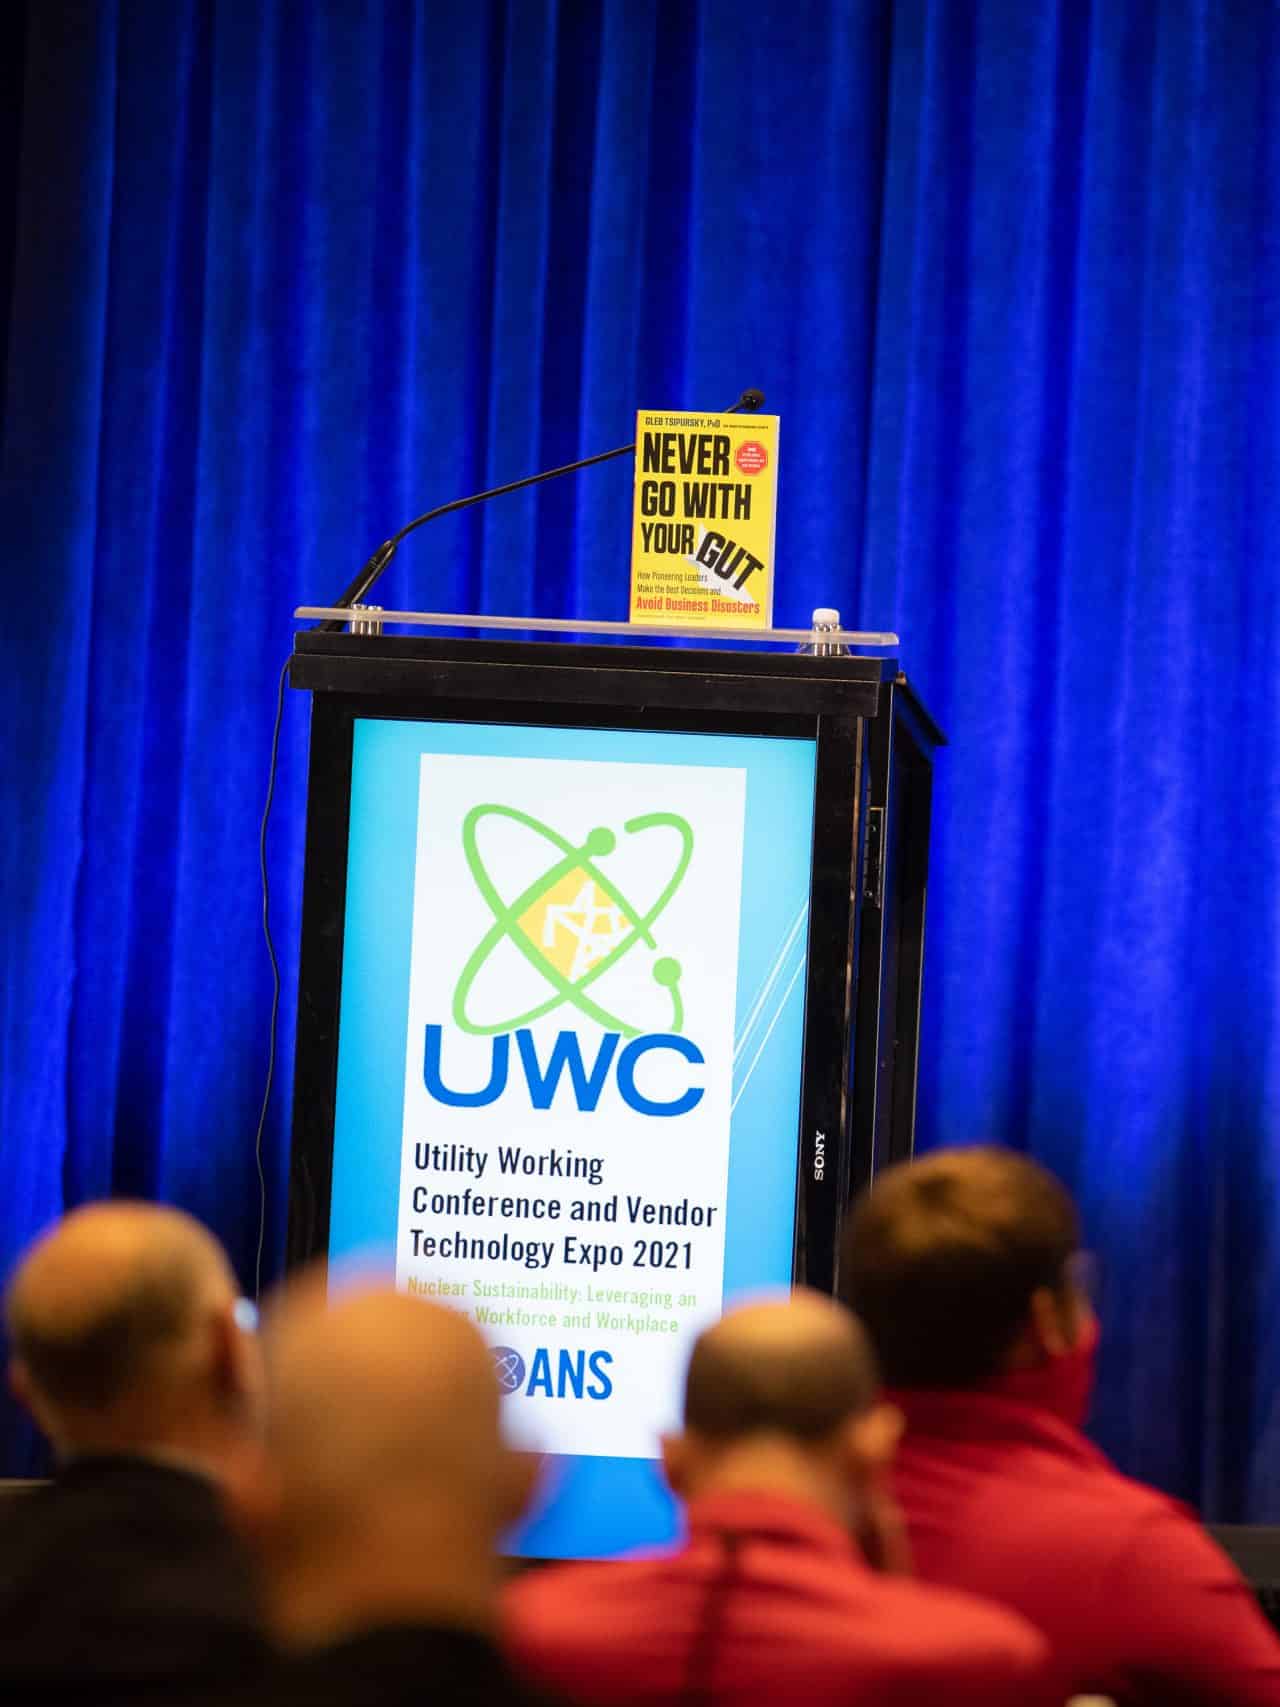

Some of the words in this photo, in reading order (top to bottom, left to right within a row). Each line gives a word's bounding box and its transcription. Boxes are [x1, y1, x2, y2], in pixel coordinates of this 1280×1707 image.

[642, 431, 731, 476] NEVER
[641, 480, 676, 517] GO
[683, 482, 752, 520] WITH
[641, 522, 694, 555] YOUR
[696, 531, 765, 590] GUT
[636, 596, 663, 610] Avoid
[666, 598, 709, 612] Business
[711, 599, 760, 614] Disasters
[637, 583, 654, 593] Make
[654, 584, 665, 593] the
[423, 1024, 705, 1117] UWC
[414, 1142, 489, 1179] Utility
[498, 1146, 605, 1185] Working
[814, 1130, 825, 1181] SONY
[412, 1187, 561, 1220] Conference
[570, 1195, 618, 1223] and
[626, 1196, 718, 1227] Vendor
[410, 1229, 555, 1269] Technology
[563, 1236, 624, 1272] Expo
[632, 1240, 692, 1270] 2021
[407, 1275, 467, 1297] Nuclear
[473, 1280, 582, 1303] Sustainability:
[587, 1284, 673, 1308] Leveraging
[677, 1292, 697, 1307] an
[475, 1306, 557, 1327] Workforce
[563, 1311, 591, 1329] and
[596, 1312, 679, 1335] Workplace
[525, 1347, 613, 1400] ANS
